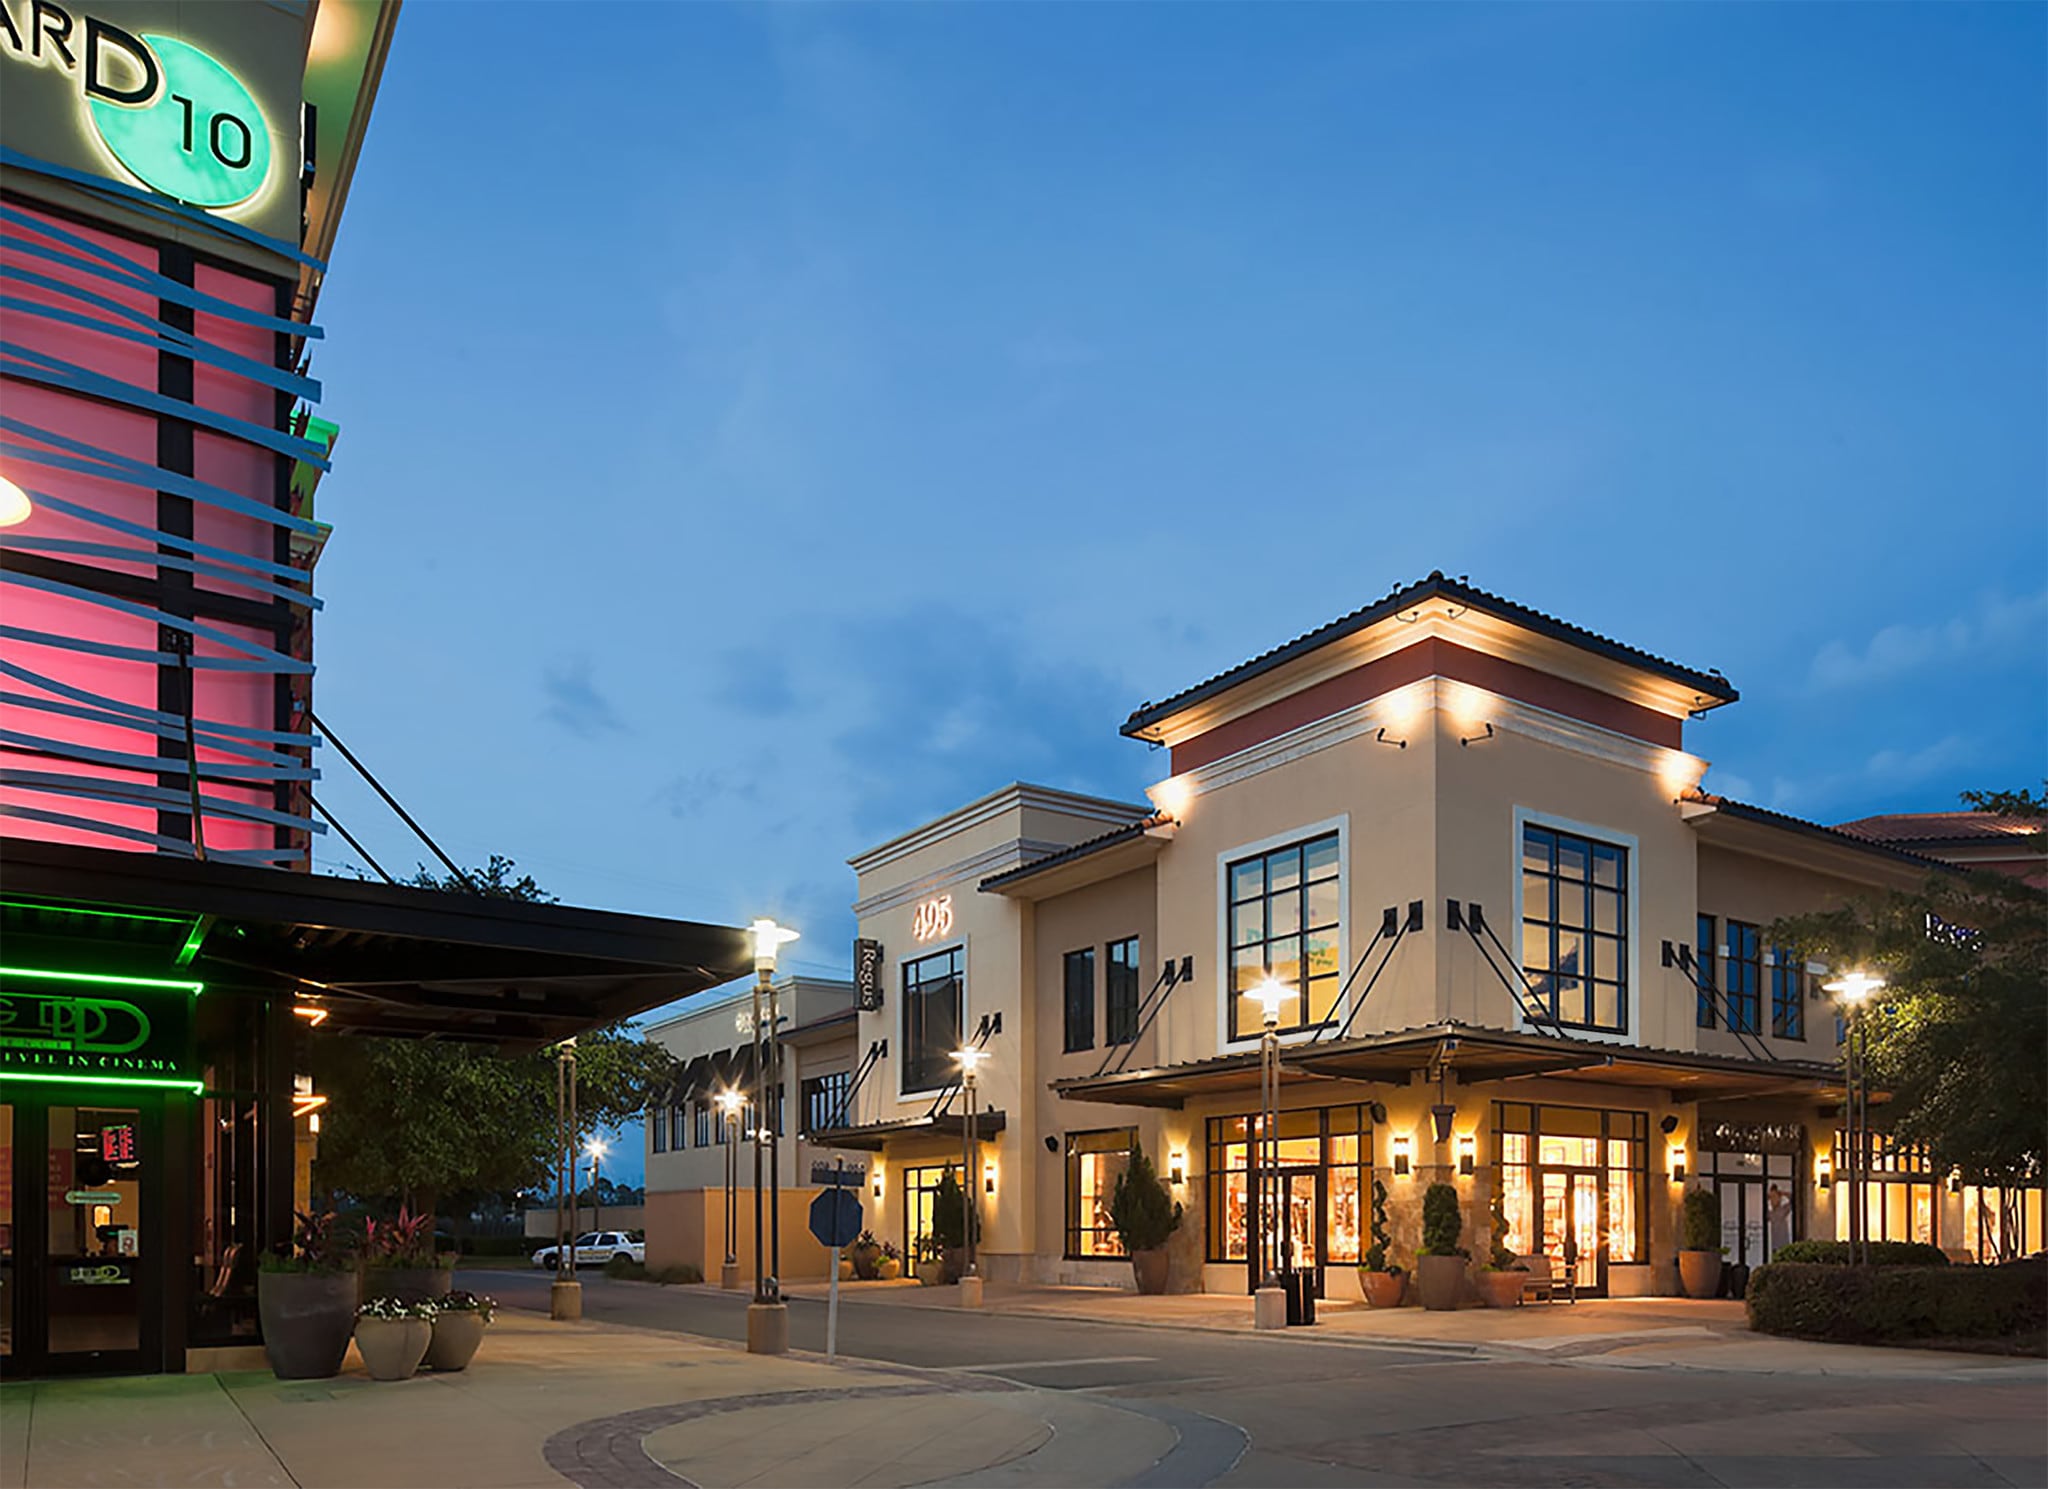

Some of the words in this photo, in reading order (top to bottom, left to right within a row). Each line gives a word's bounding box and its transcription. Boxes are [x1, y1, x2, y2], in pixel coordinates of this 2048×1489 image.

[171, 93, 251, 169] 10
[912, 894, 953, 941] 495
[859, 949, 876, 1006] Regus
[99, 1056, 176, 1071] CINEMA
